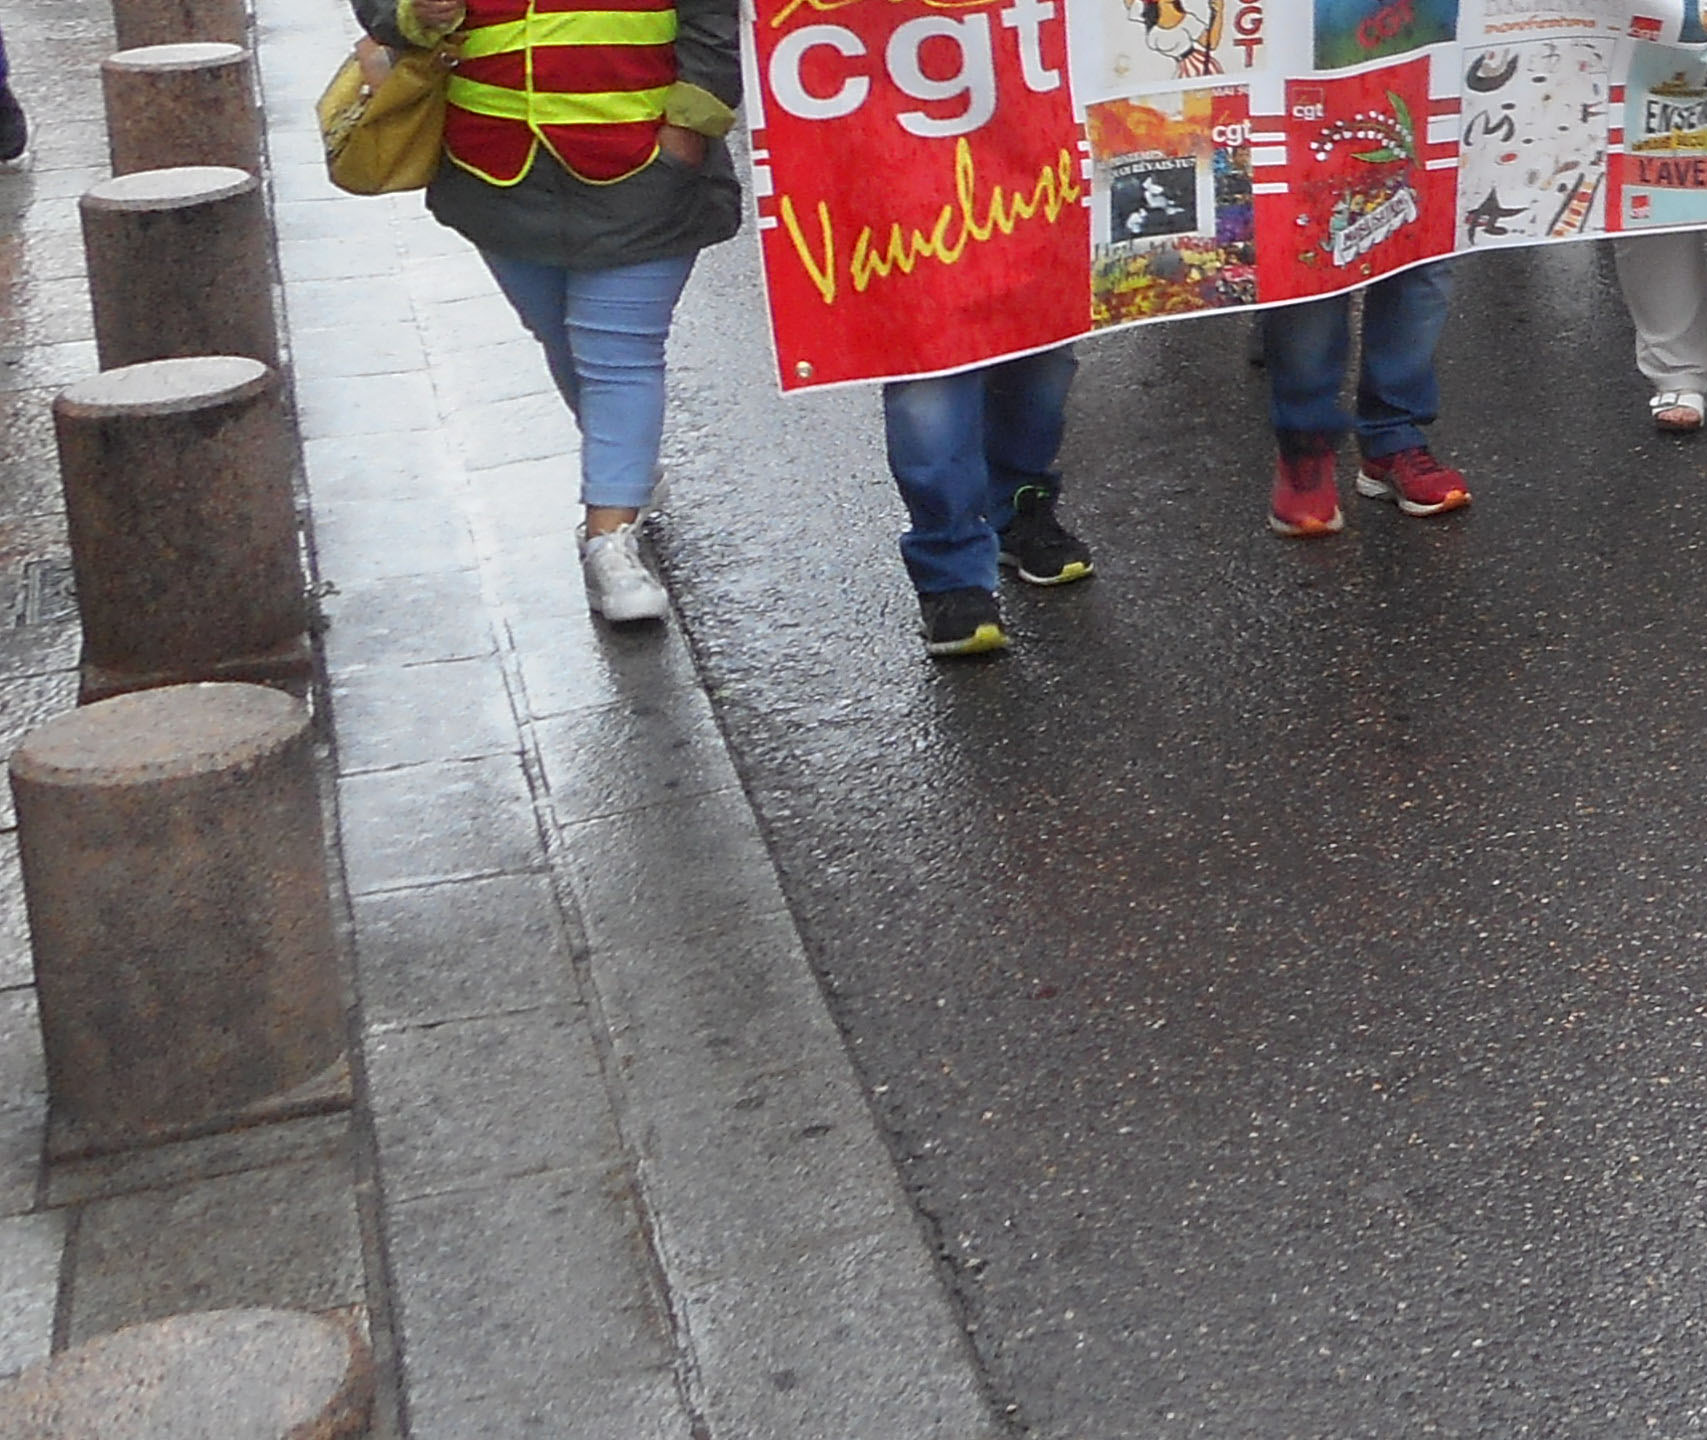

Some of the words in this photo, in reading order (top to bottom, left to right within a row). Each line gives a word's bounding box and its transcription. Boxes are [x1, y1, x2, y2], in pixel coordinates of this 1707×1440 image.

[1292, 103, 1324, 120] cgt
[1212, 119, 1252, 146] cgt
[781, 138, 1079, 303] Vaucluse
